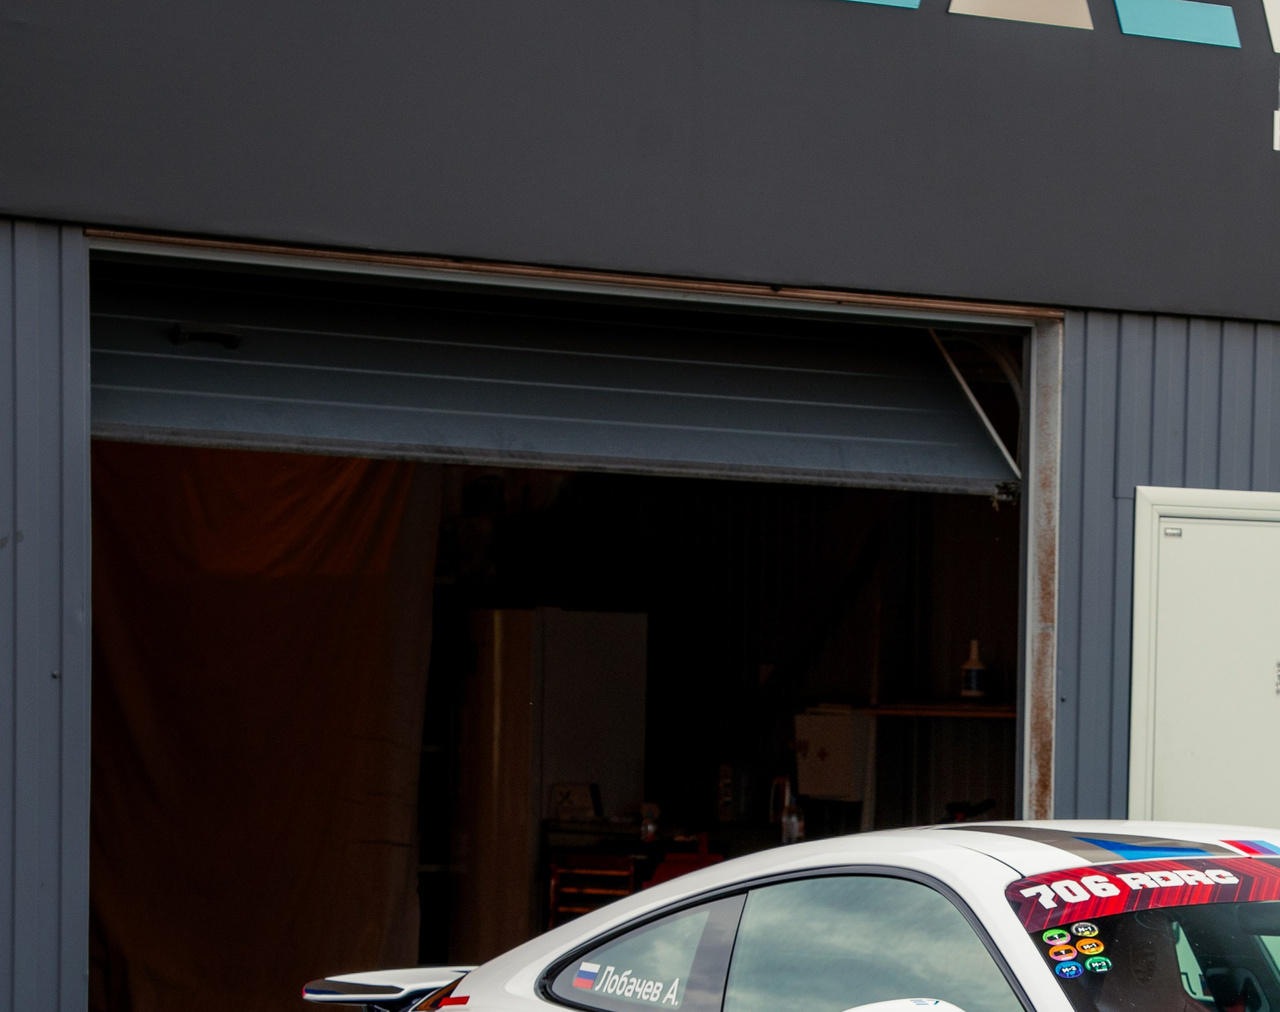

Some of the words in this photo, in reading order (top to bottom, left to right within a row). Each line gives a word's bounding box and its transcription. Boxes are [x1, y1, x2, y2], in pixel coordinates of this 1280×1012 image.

[1019, 875, 1121, 910] 706
[1114, 868, 1240, 891] RDRC
[594, 965, 664, 1002] Лобачев
